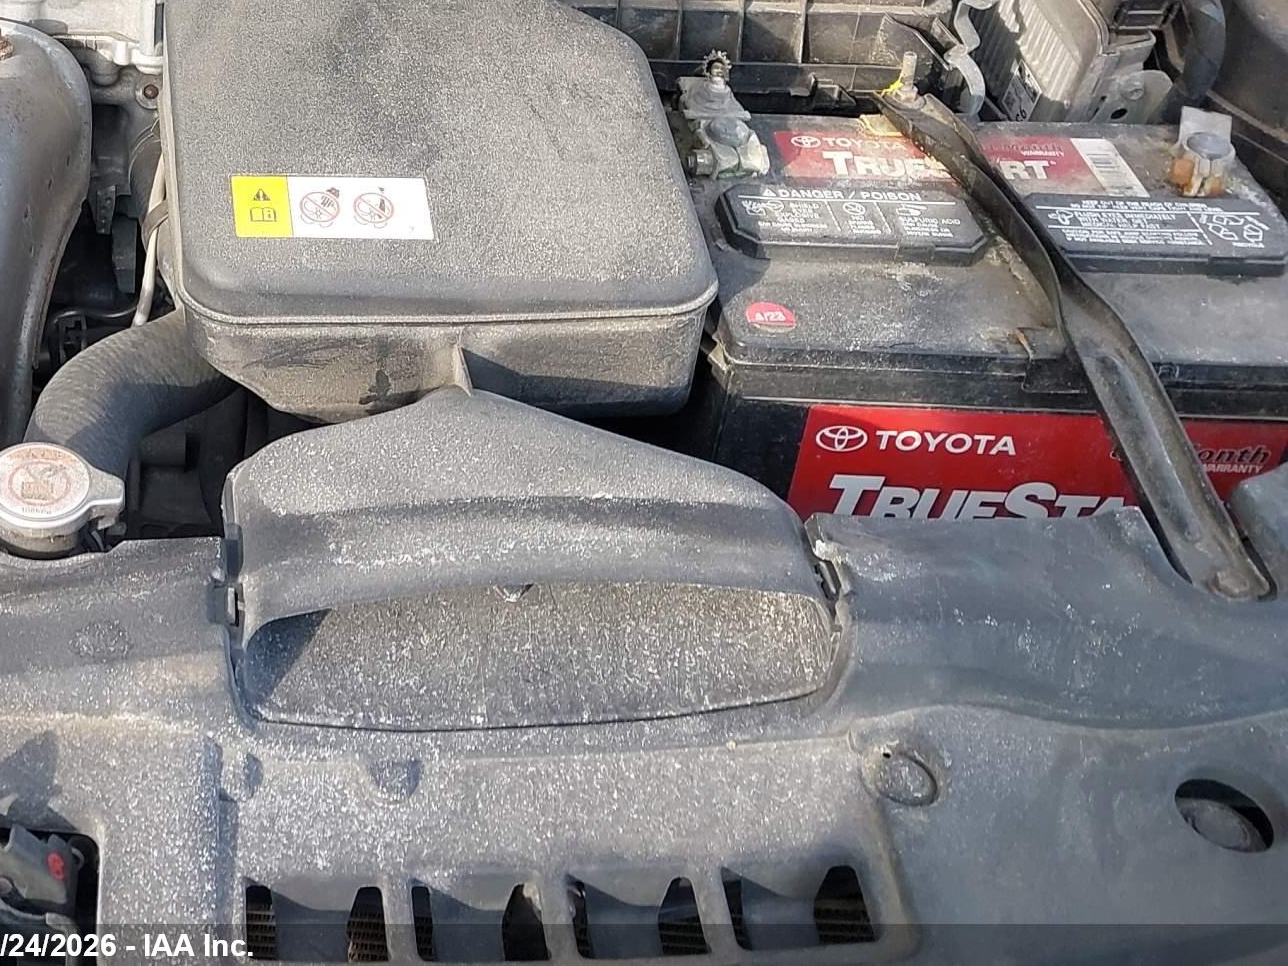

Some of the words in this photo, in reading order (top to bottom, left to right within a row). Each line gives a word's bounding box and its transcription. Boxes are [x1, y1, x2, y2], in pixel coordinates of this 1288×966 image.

[823, 137, 907, 150] TOYOTA
[779, 189, 844, 199] DANGER
[860, 191, 921, 201] POISON
[876, 431, 1016, 456] TOYOTA
[1206, 464, 1264, 474] ARRANTY
